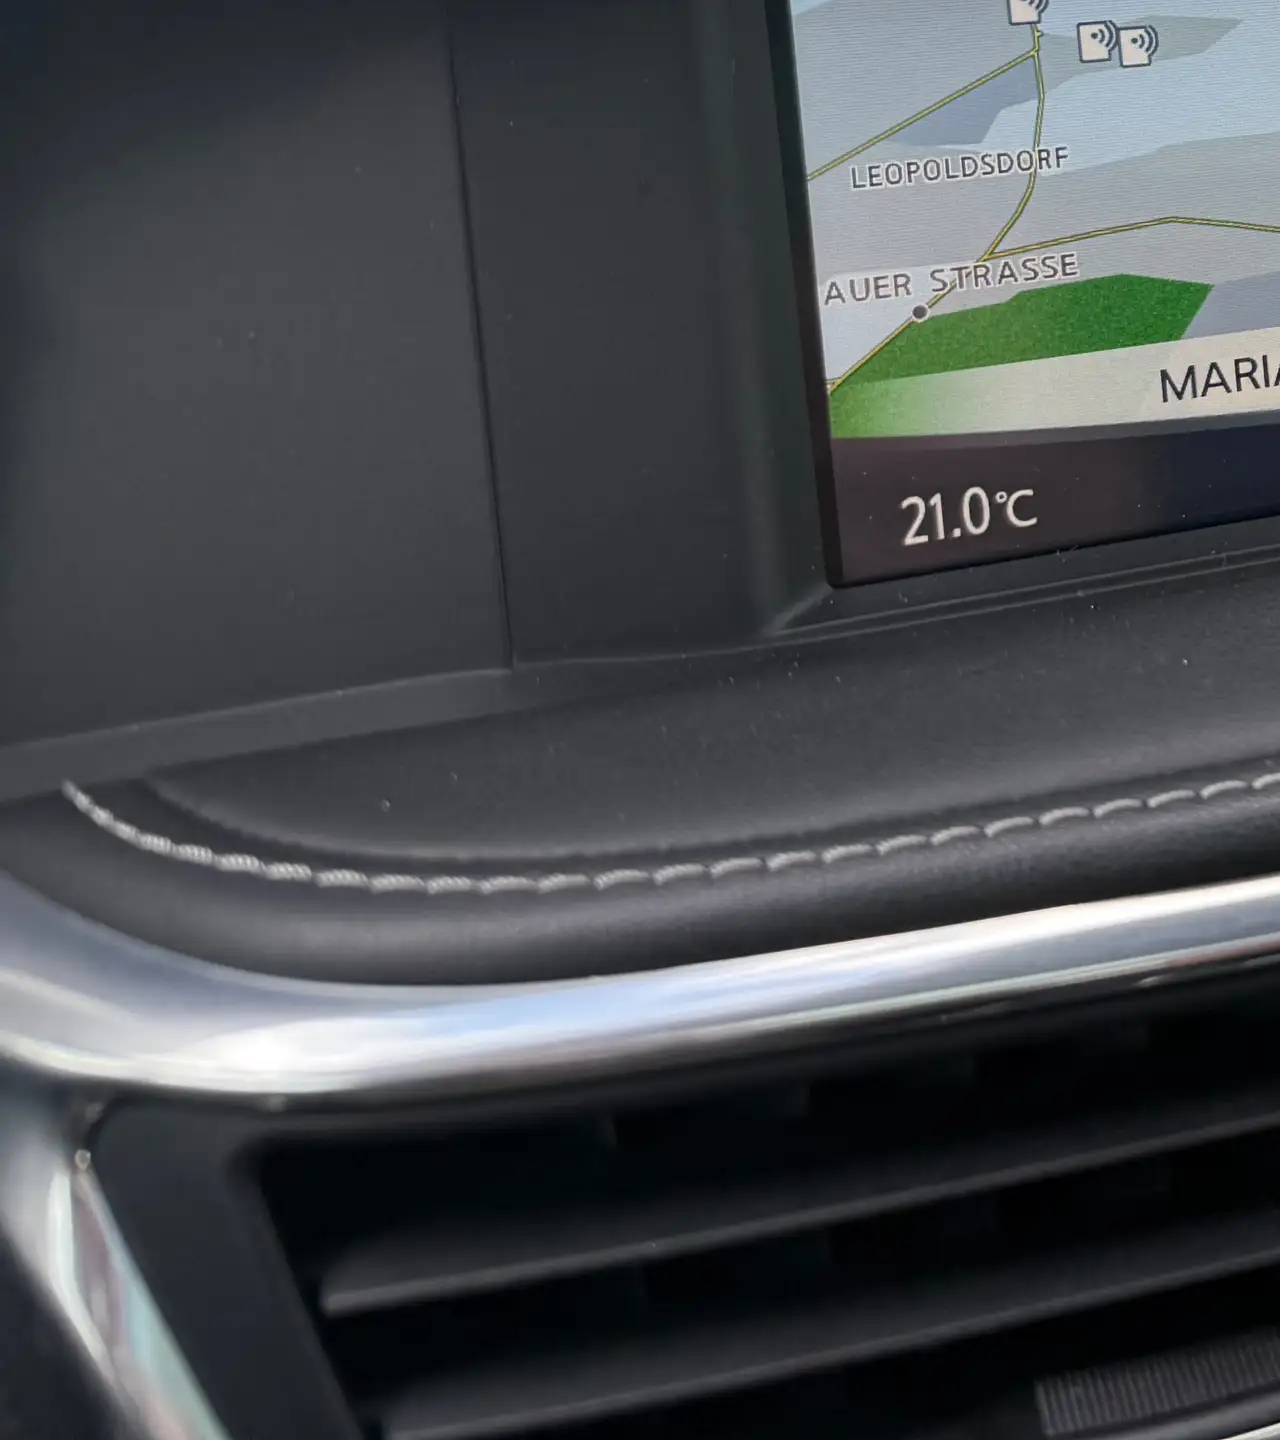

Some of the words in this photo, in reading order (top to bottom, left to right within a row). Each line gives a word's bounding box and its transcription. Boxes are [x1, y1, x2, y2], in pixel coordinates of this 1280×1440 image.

[850, 145, 1069, 190] LEOPOLDSDORF
[824, 272, 913, 306] AUER
[930, 252, 1079, 293] STRASSE
